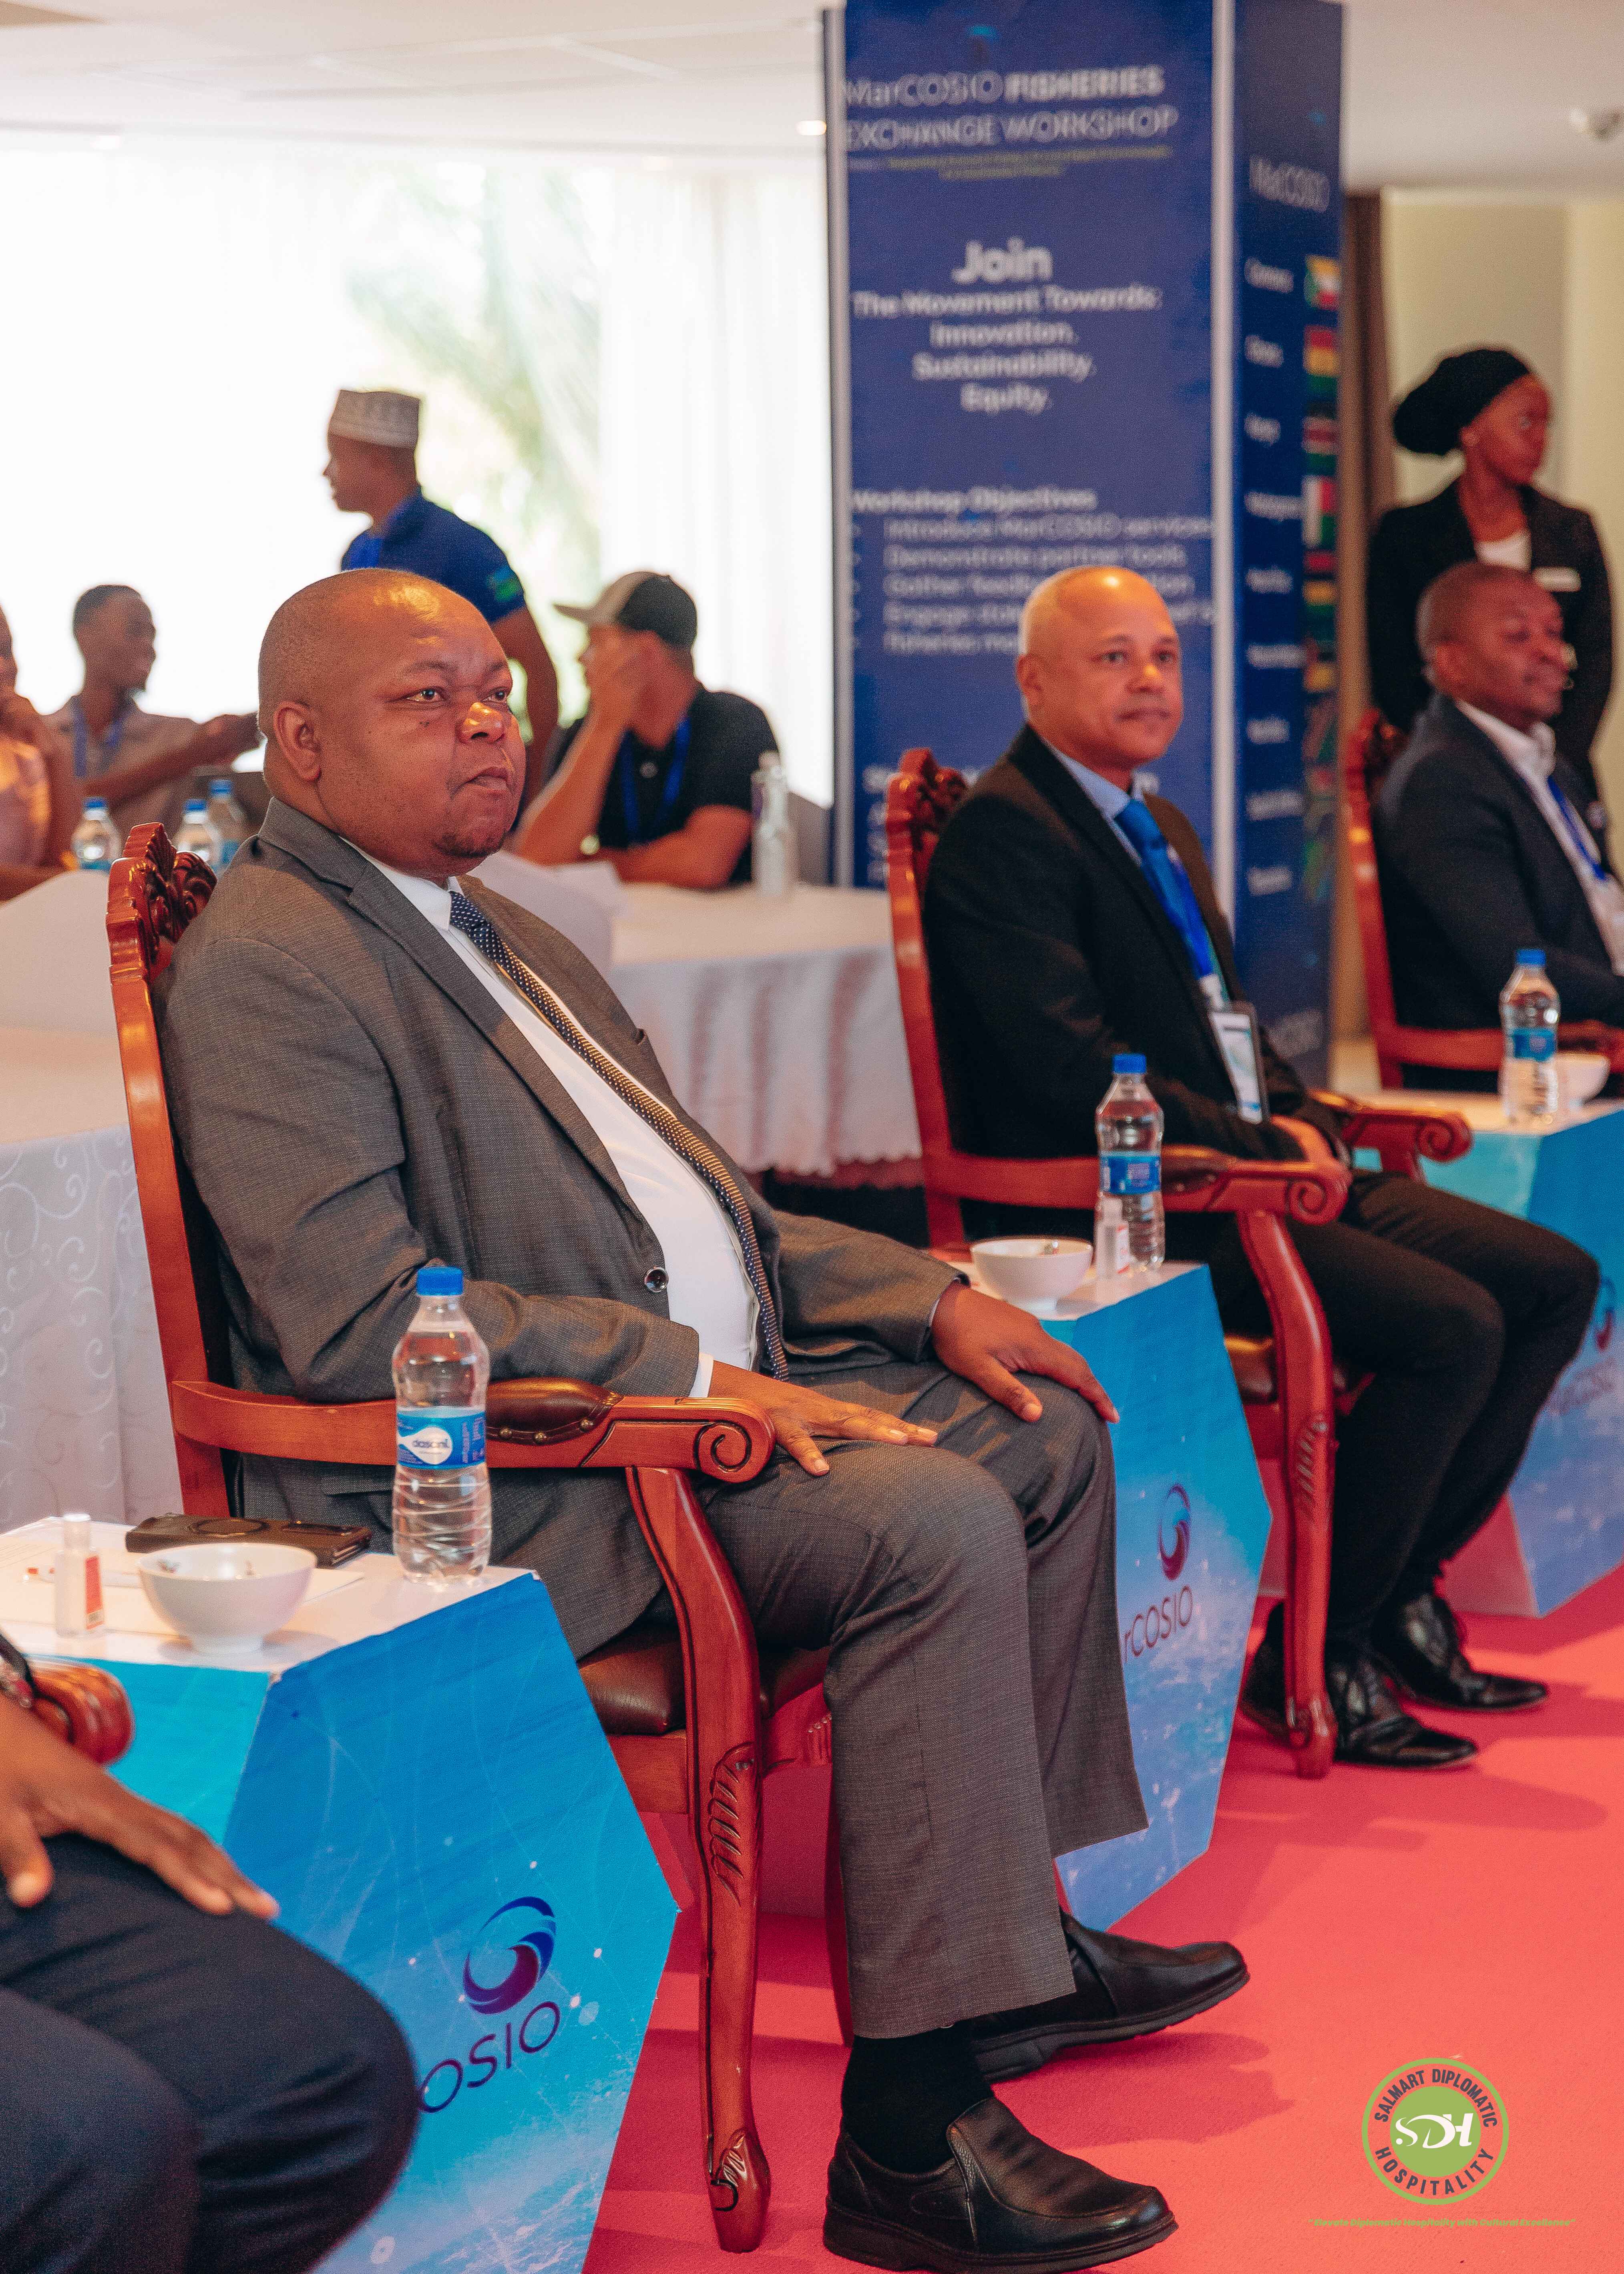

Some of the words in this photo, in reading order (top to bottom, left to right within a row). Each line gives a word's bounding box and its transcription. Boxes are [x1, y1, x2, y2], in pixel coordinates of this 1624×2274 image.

[1007, 66, 1163, 102] FISHERIES
[1003, 106, 1176, 142] WORKSHOP
[953, 239, 1052, 282] Join
[853, 292, 898, 316] The
[903, 289, 1039, 315] Movement
[1124, 1584, 1192, 1663] rCOSIO
[418, 2001, 561, 2113] OSIO
